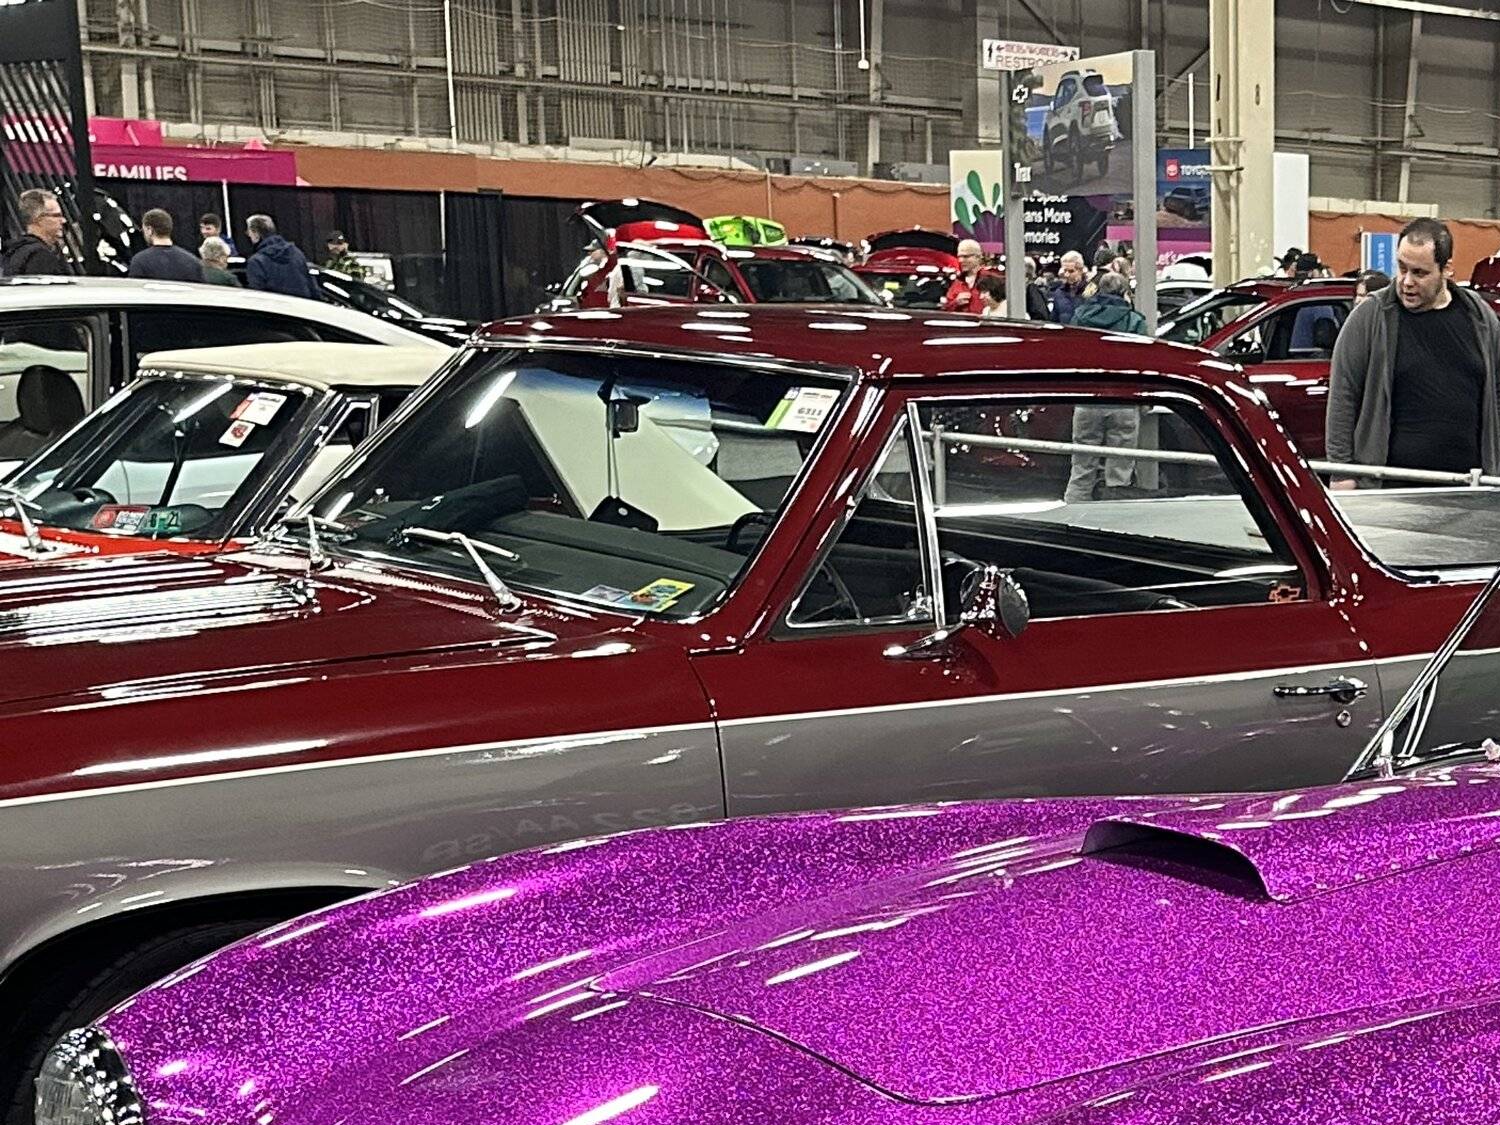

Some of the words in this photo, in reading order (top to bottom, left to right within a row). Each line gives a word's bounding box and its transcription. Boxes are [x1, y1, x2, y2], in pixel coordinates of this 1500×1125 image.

[996, 55, 1064, 68] RESTROO
[1023, 211, 1043, 223] ans
[1044, 208, 1072, 224] More
[1023, 228, 1060, 244] mories
